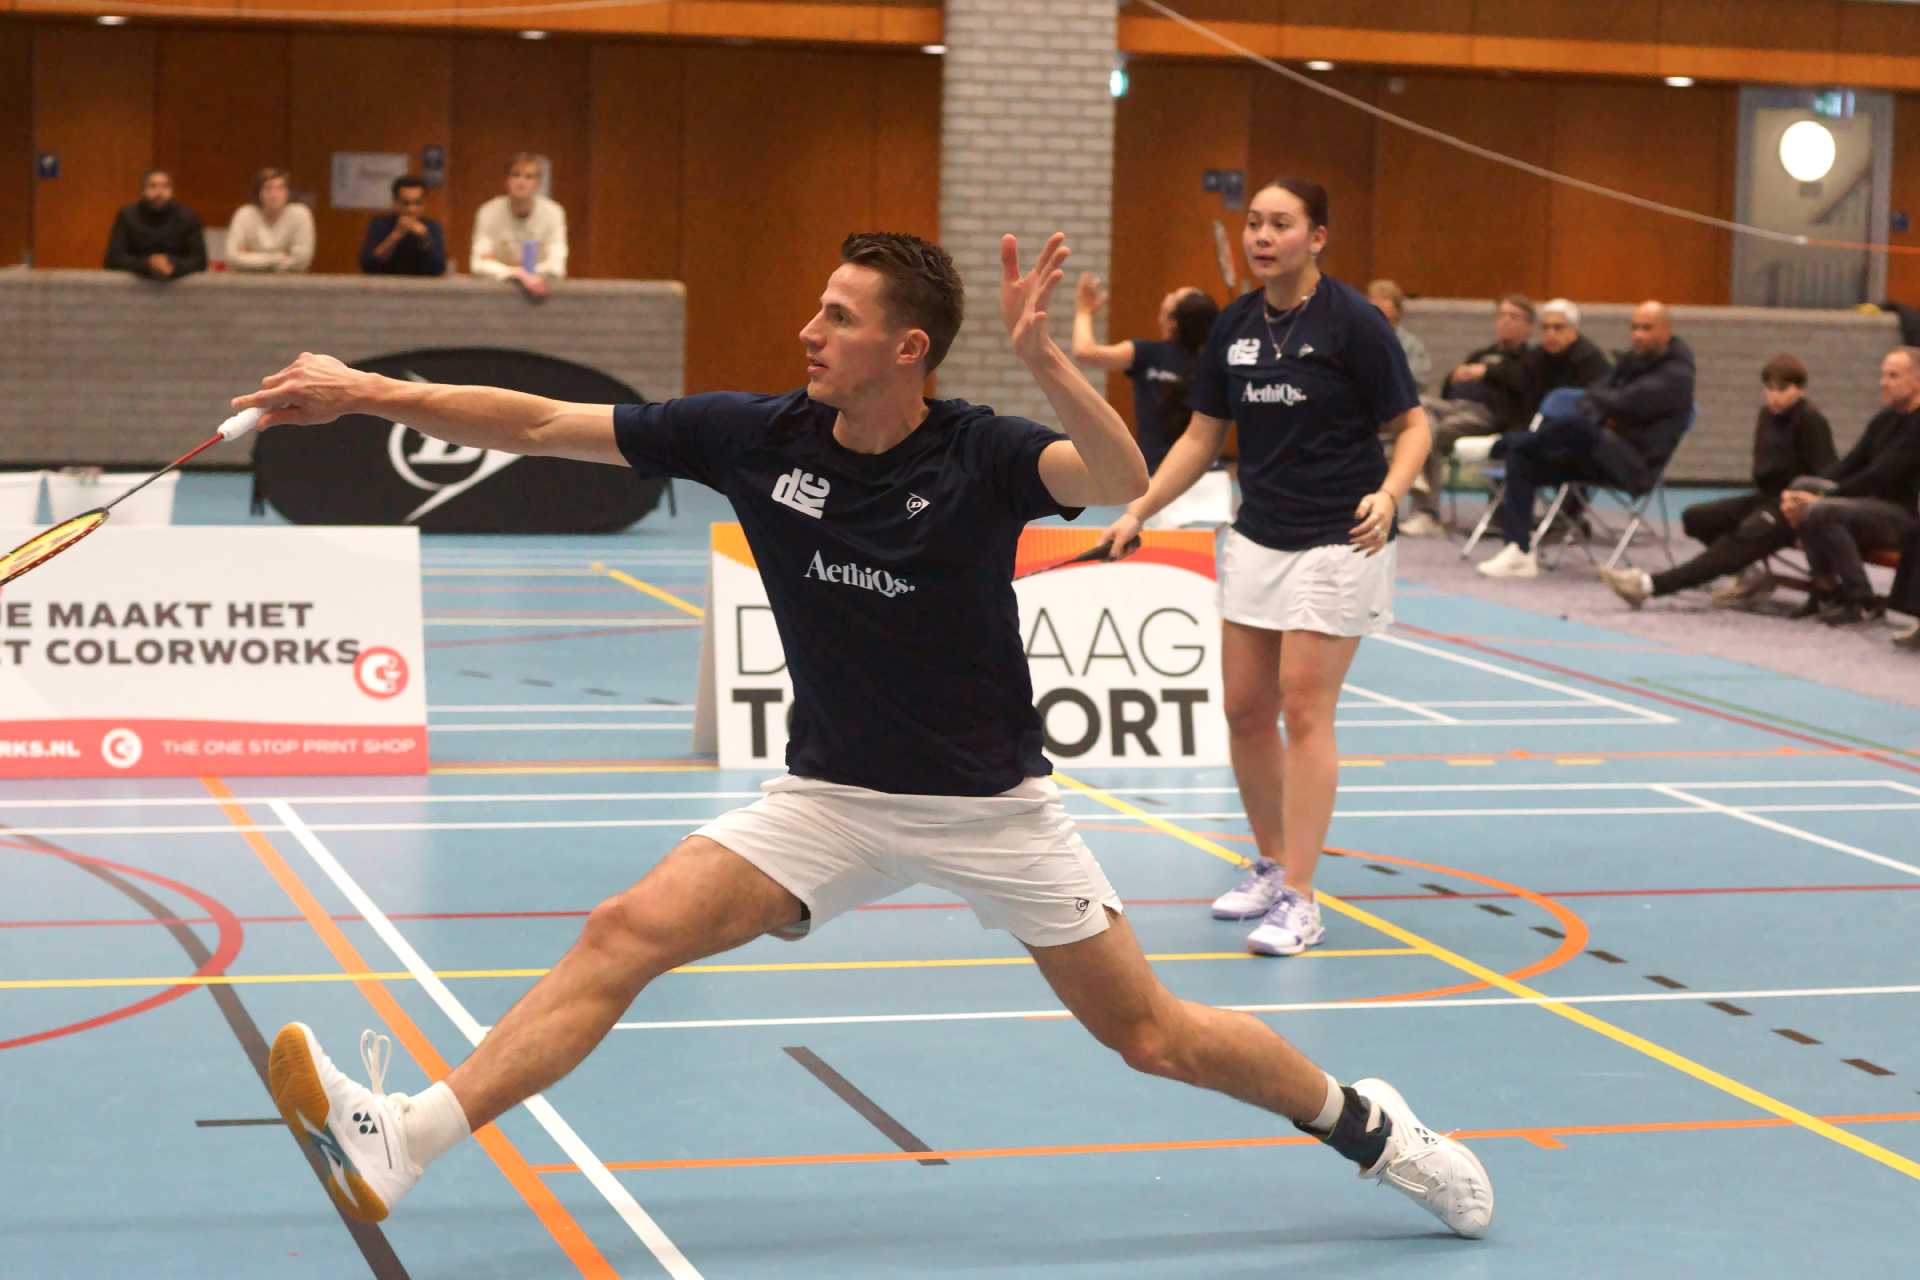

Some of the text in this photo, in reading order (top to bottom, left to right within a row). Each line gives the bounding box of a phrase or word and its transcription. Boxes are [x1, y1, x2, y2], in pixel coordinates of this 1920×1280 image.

[0, 602, 314, 628] E MAAKT HET
[46, 638, 361, 666] COLORWORKS
[1025, 607, 1205, 678] AAG
[161, 737, 417, 756] THE ONE STOP PRINT SHOP
